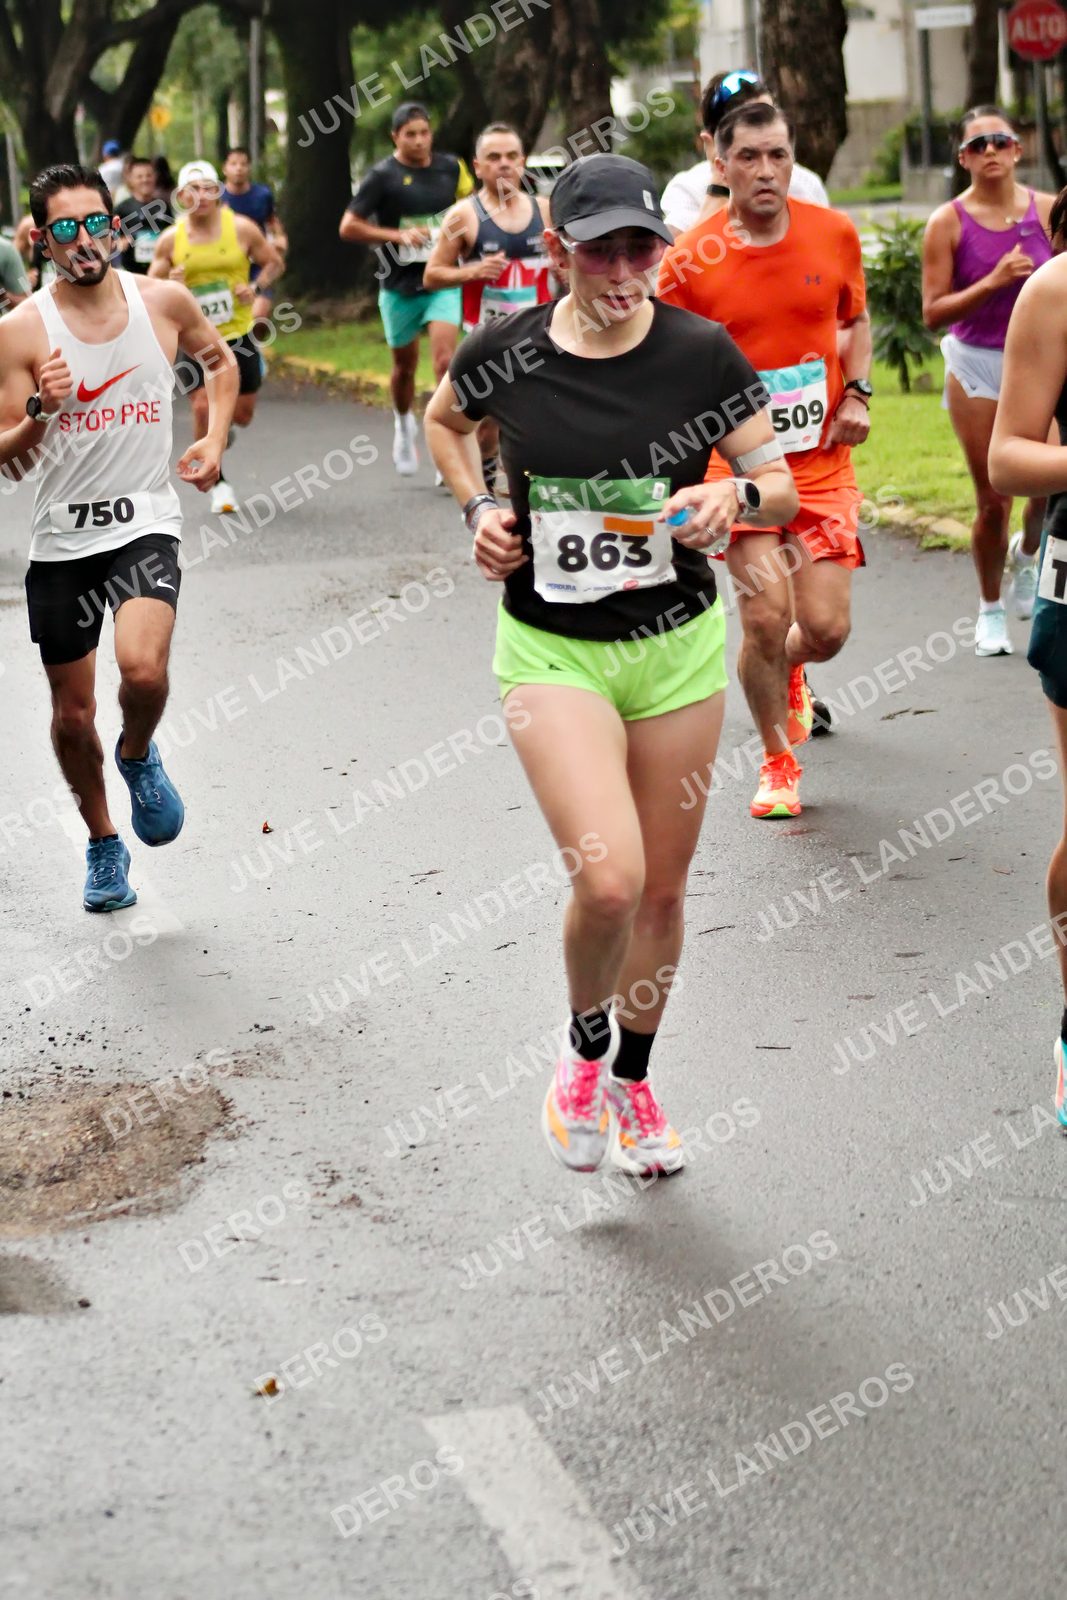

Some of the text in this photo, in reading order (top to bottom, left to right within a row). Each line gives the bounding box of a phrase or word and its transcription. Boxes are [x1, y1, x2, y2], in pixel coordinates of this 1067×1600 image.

[1012, 13, 1065, 42] ALTO
[59, 401, 161, 432] STOP PRE
[771, 400, 824, 433] 509
[68, 497, 135, 528] 750
[557, 532, 652, 573] 863
